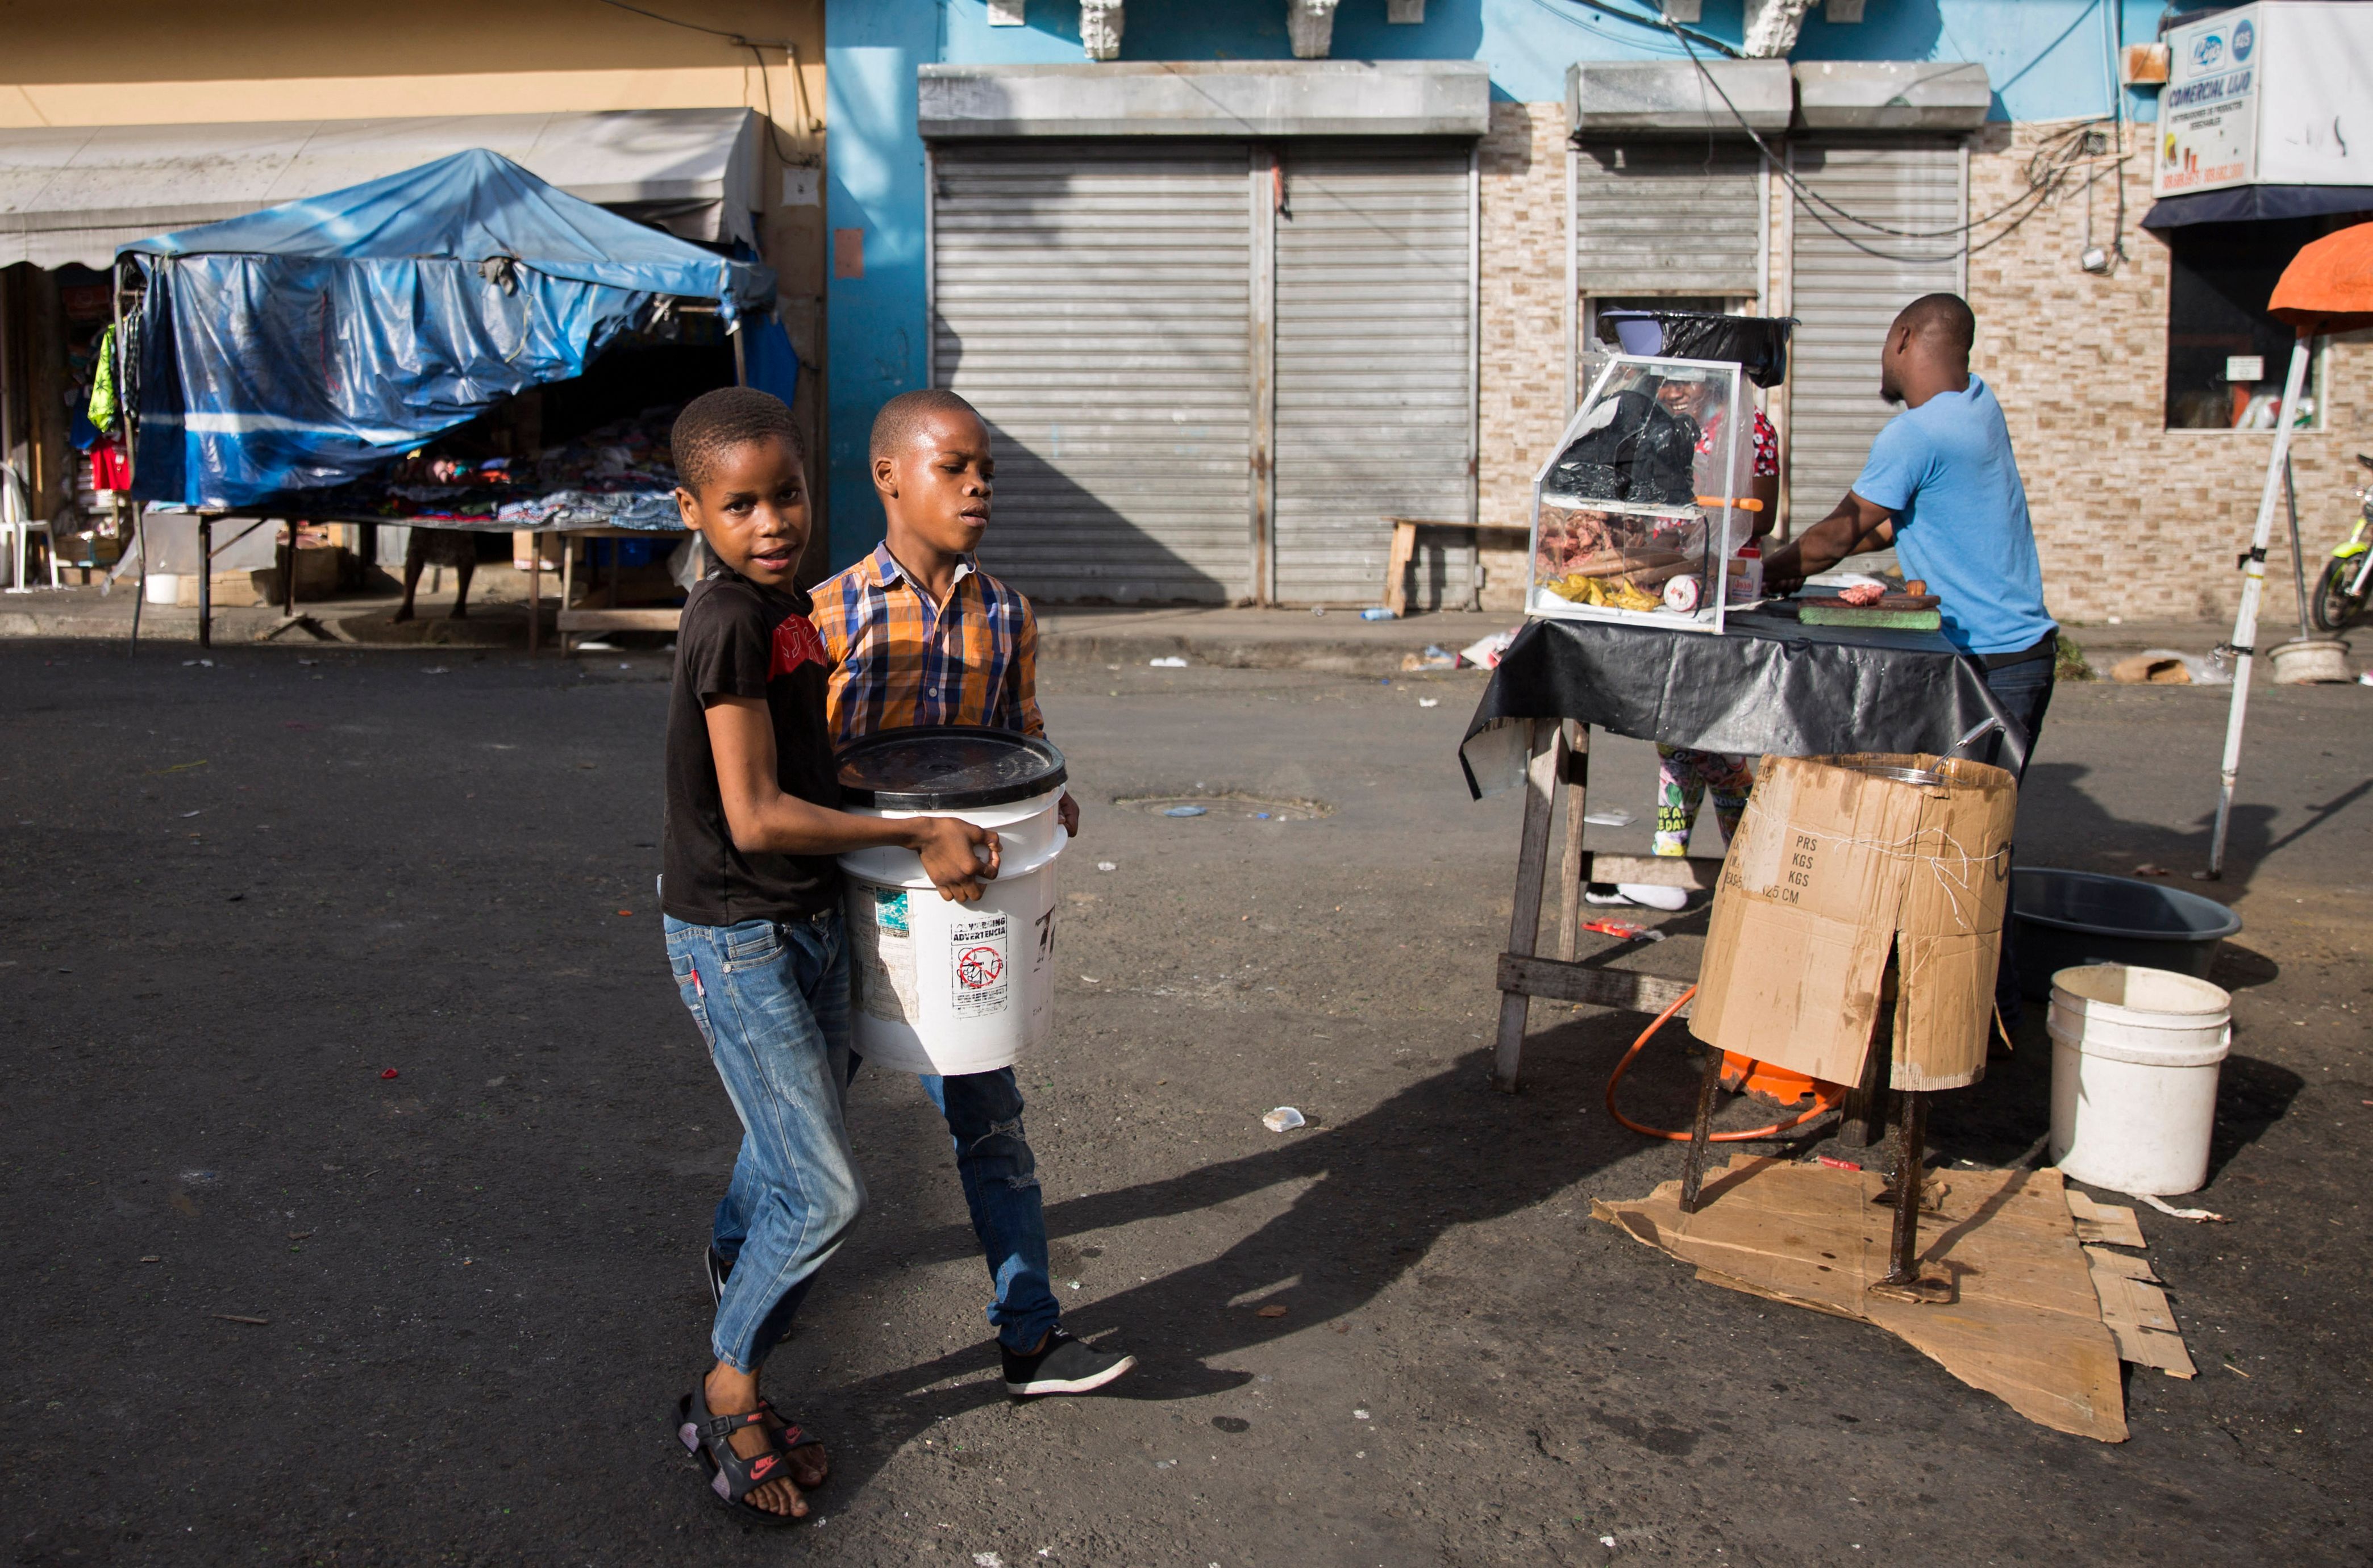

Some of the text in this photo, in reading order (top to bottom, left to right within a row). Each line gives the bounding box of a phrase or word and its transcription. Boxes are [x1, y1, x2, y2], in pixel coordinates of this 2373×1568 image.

[2168, 78, 2224, 108] COMERCIAL
[1796, 835, 1817, 851] PRS
[1792, 853, 1813, 869] KGS
[1788, 870, 1809, 887] KGS
[1782, 889, 1799, 904] CM
[954, 927, 1005, 941] ADVERTENCIA
[755, 1455, 774, 1470] NIKE
